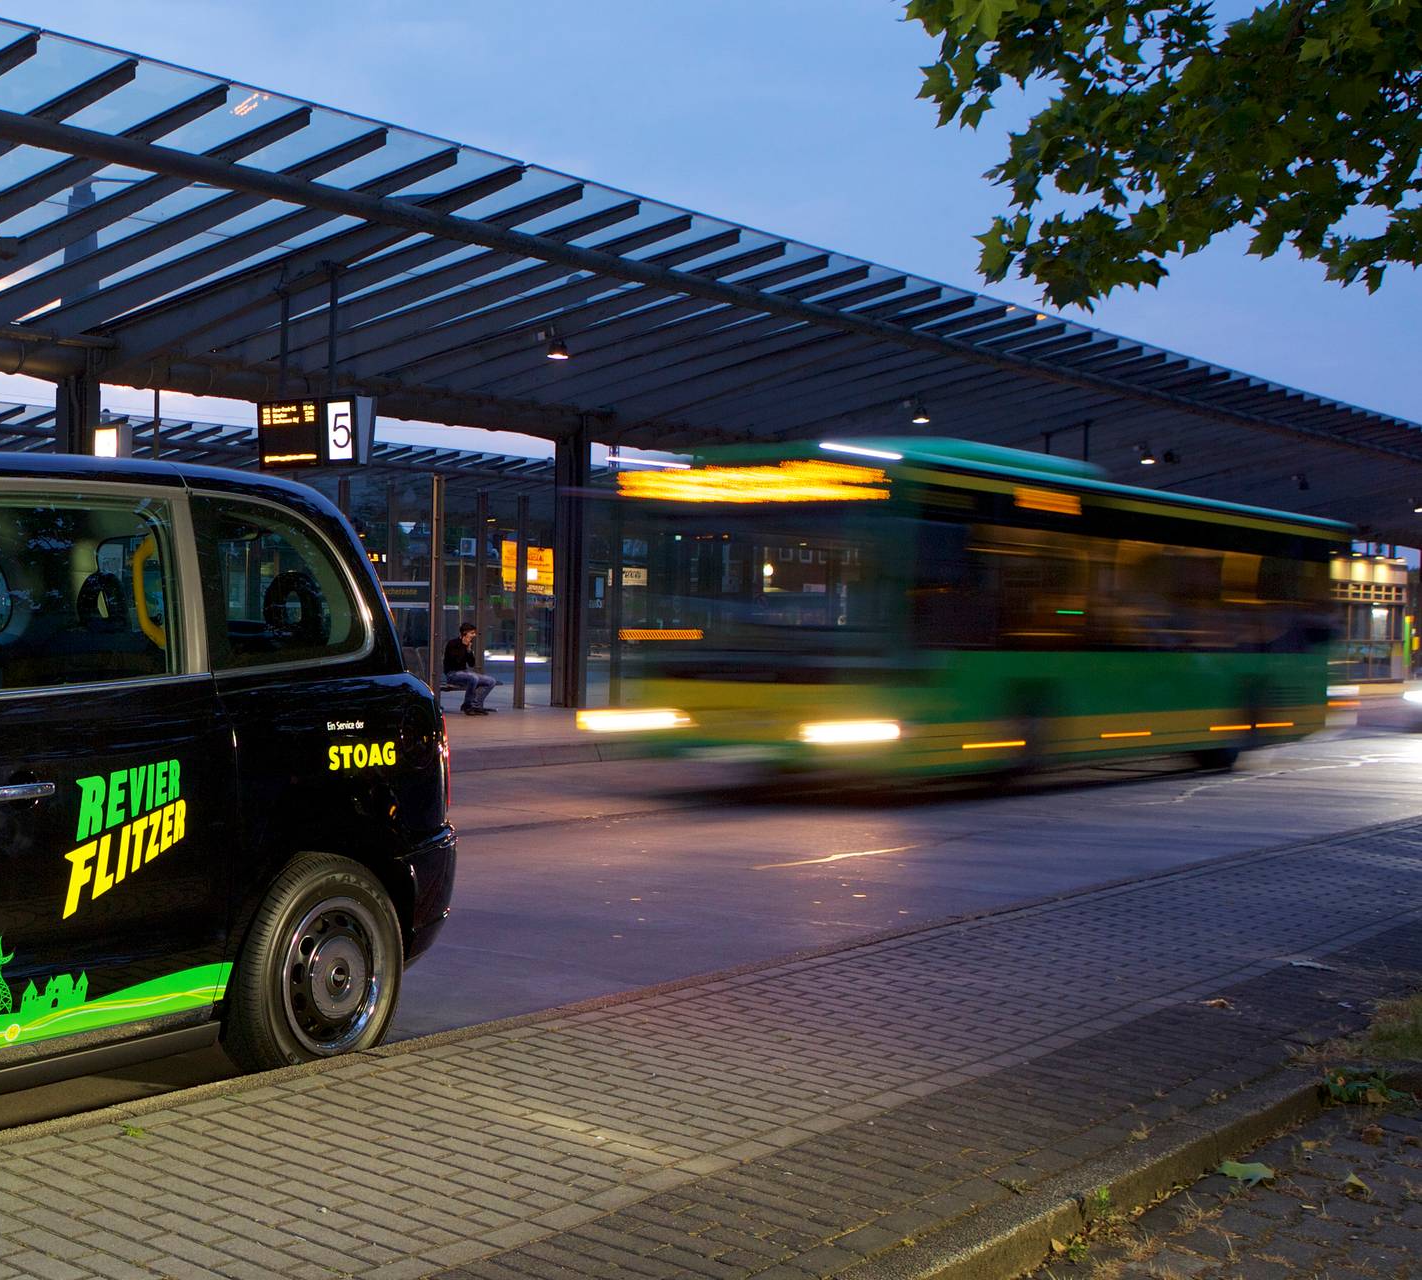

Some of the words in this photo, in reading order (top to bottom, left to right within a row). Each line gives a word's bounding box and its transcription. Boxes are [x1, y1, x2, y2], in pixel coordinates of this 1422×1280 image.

[333, 413, 350, 448] 5
[327, 721, 336, 731] Ein
[336, 720, 355, 730] Service
[355, 720, 364, 729] der
[328, 741, 396, 770] STOAG
[76, 759, 181, 842] REVIER
[62, 799, 187, 920] FLITZER
